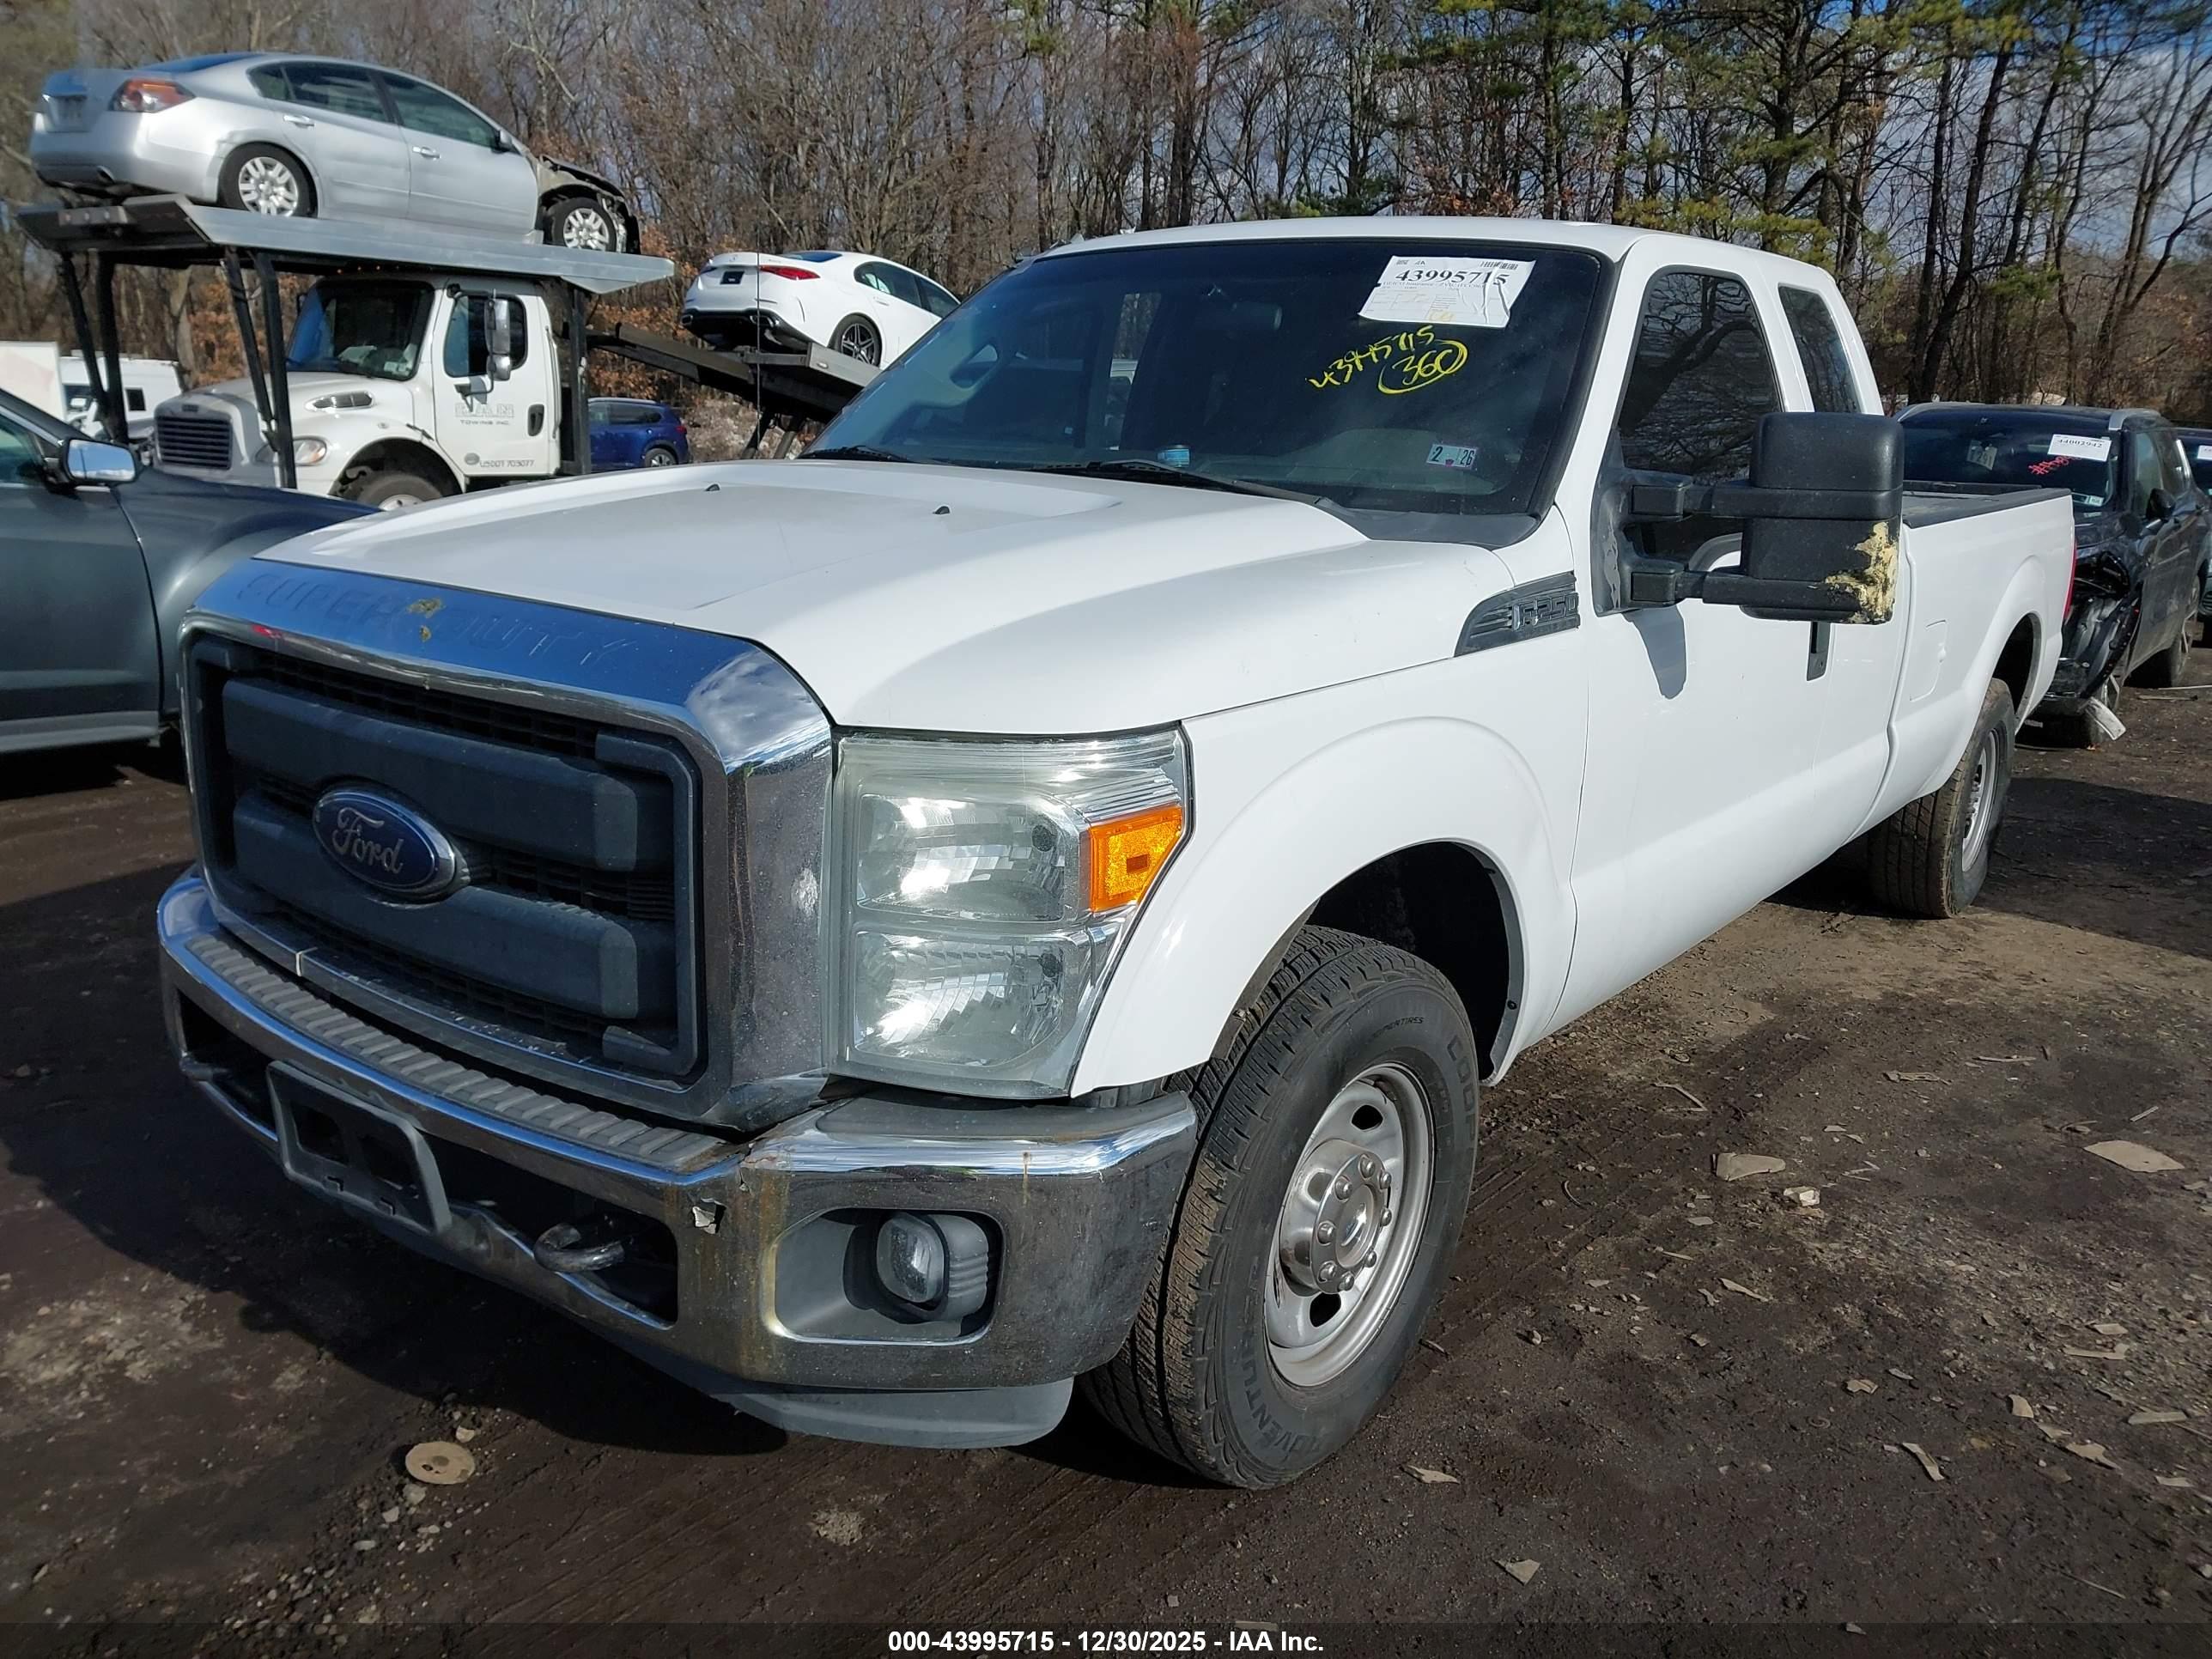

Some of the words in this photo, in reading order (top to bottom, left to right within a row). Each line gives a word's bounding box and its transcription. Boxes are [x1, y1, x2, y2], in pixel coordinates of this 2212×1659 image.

[1395, 270, 1510, 286] 43995715
[1431, 446, 1443, 462] 2
[1460, 449, 1475, 465] 26
[331, 806, 405, 874] Ford
